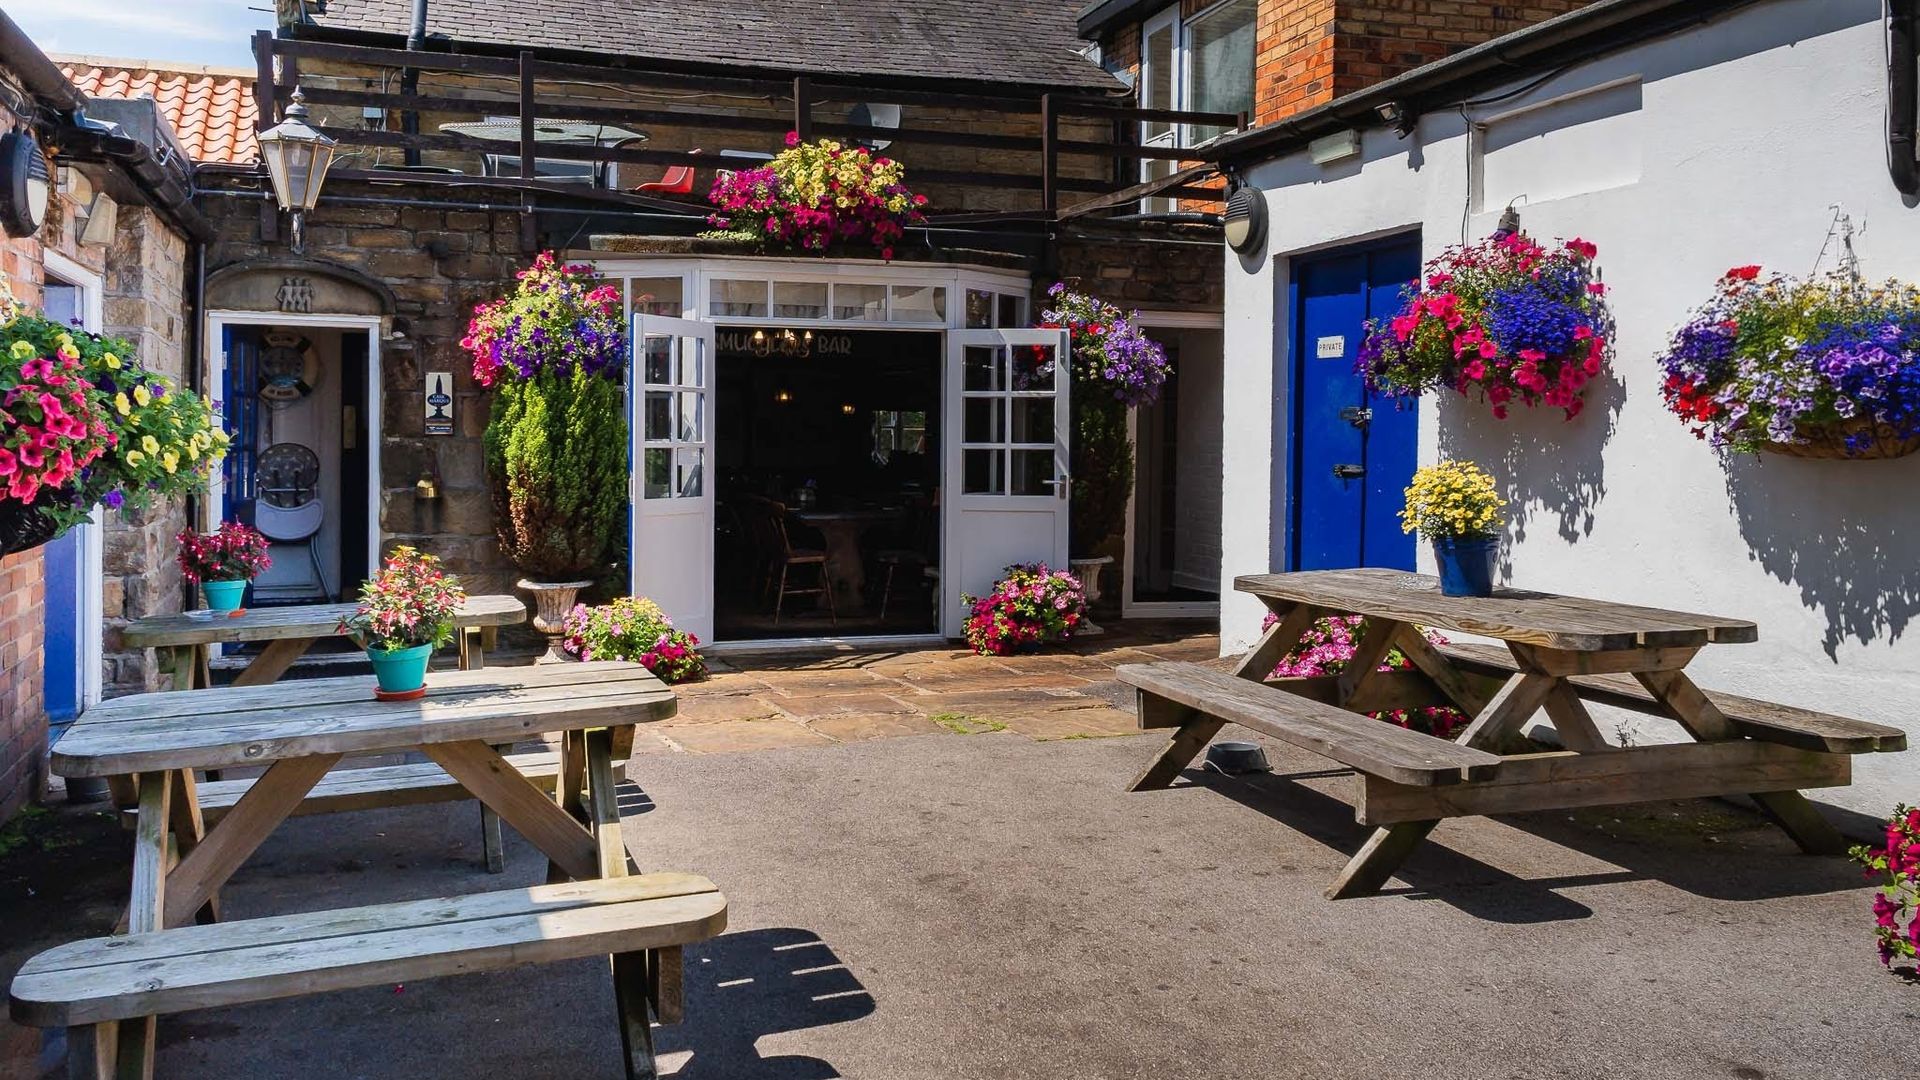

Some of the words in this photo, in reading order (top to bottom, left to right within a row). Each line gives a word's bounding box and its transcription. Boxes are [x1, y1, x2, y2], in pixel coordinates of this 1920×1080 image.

[716, 333, 812, 354] MUGLES
[818, 335, 851, 354] BAR
[1319, 342, 1343, 351] PRIVATE
